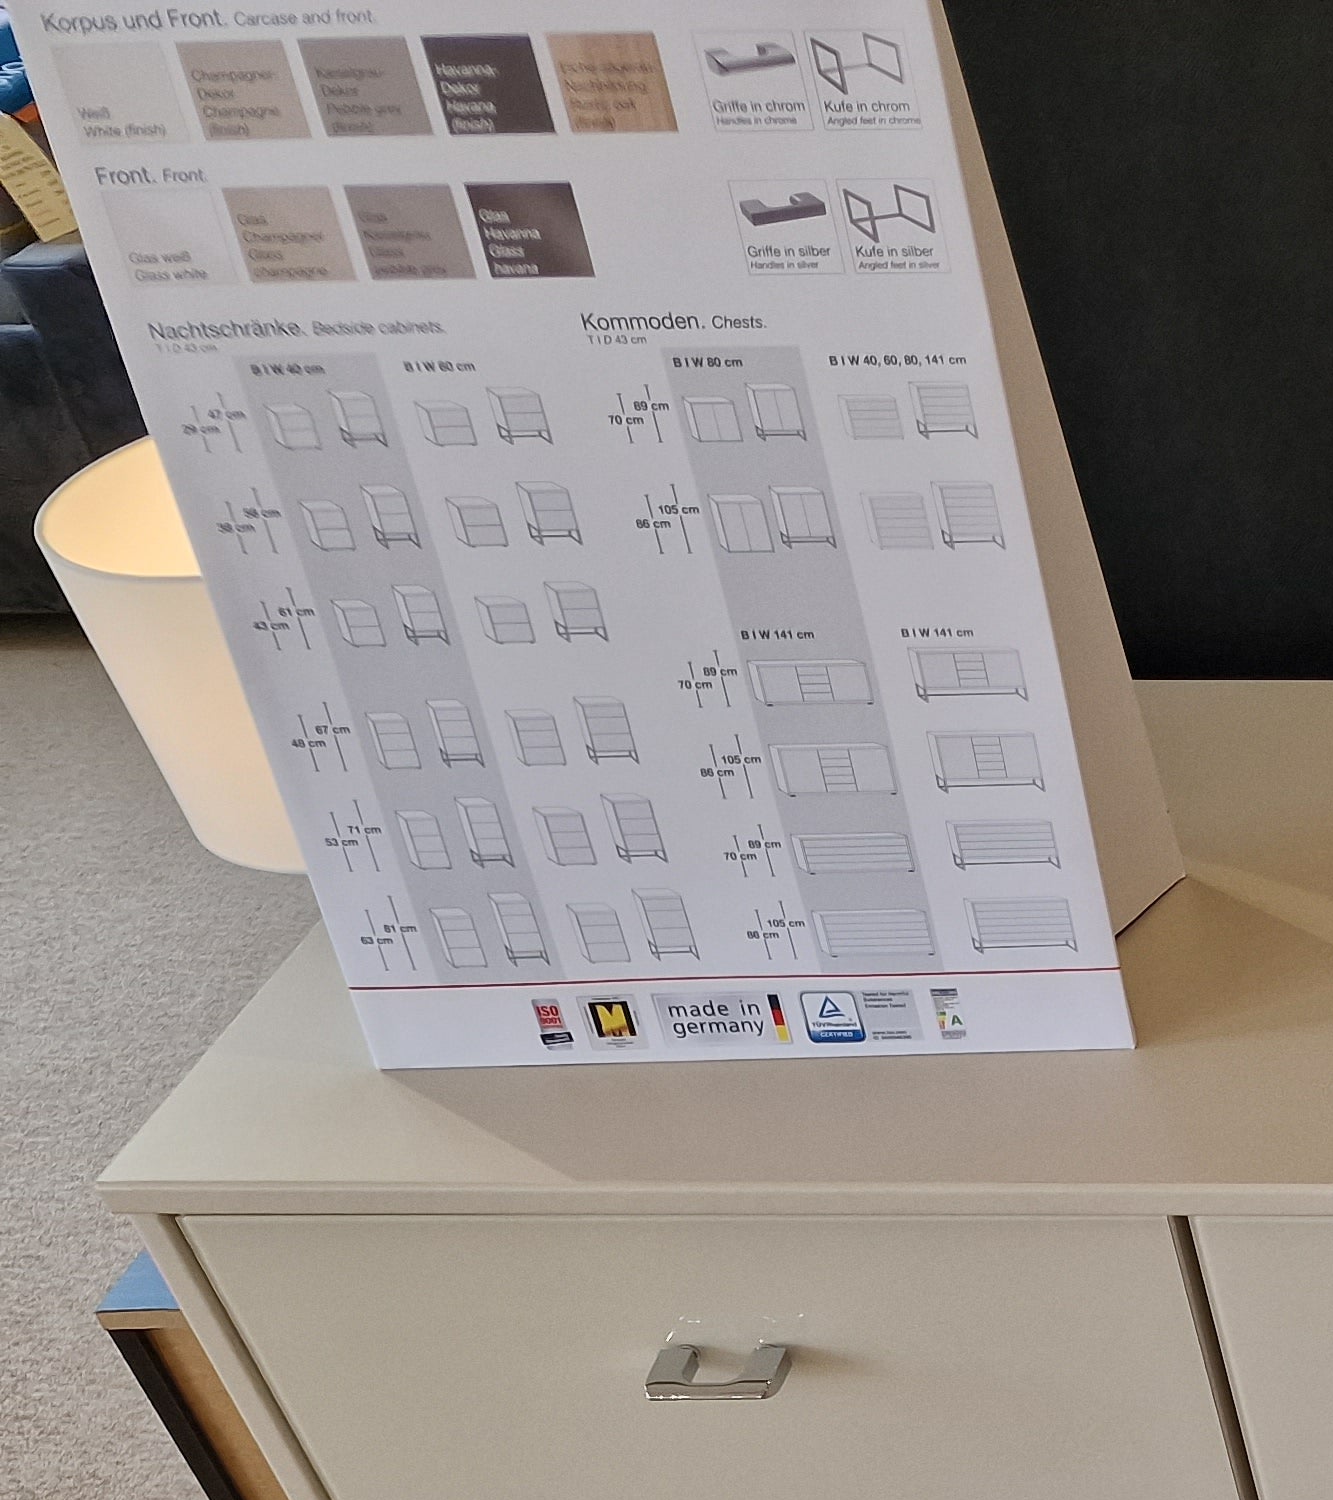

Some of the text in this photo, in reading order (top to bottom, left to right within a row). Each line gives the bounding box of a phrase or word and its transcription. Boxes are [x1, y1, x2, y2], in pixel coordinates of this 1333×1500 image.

[40, 13, 117, 34] Korpus
[122, 13, 162, 30] und
[167, 9, 228, 27] Front.
[234, 12, 297, 26] Carcase
[302, 10, 330, 24] and
[713, 100, 805, 113] Griffe in chrom
[824, 101, 910, 113] Kufe in chrom
[95, 167, 207, 185] Front. Front.
[747, 245, 830, 257] Griffe in silber
[855, 246, 933, 257] Kufe in silber
[581, 312, 767, 331] Kommoden. Chests.
[148, 319, 307, 341] Nachtschränke.
[311, 320, 374, 336] Bedside
[615, 335, 627, 344] 43
[673, 357, 743, 368] B W 80 cm
[829, 356, 839, 366] B
[847, 356, 860, 365] W
[924, 355, 945, 365] 141
[949, 357, 967, 365] cm
[455, 362, 476, 372] cm
[651, 403, 670, 411] cm
[608, 415, 644, 425] 70 cm
[658, 504, 700, 515] 105 cm
[653, 520, 671, 528] cm
[297, 608, 315, 617] cm
[271, 622, 290, 631] cm
[741, 630, 815, 640] B W 141 cm
[901, 627, 974, 638] B W 141 cm
[720, 669, 738, 677] cm
[678, 680, 713, 690] 70 cm
[332, 726, 350, 735] cm
[308, 740, 326, 748] cm
[721, 755, 762, 764] 105 cm
[717, 769, 735, 777] cm
[347, 826, 360, 834] 71
[325, 838, 359, 847] 53 cm
[764, 841, 782, 849] cm
[723, 852, 757, 861] 70 cm
[767, 919, 786, 928] 105
[536, 1005, 559, 1017] ISO
[668, 1000, 761, 1018] made in
[951, 1014, 963, 1026] A
[673, 1020, 764, 1038] germany
